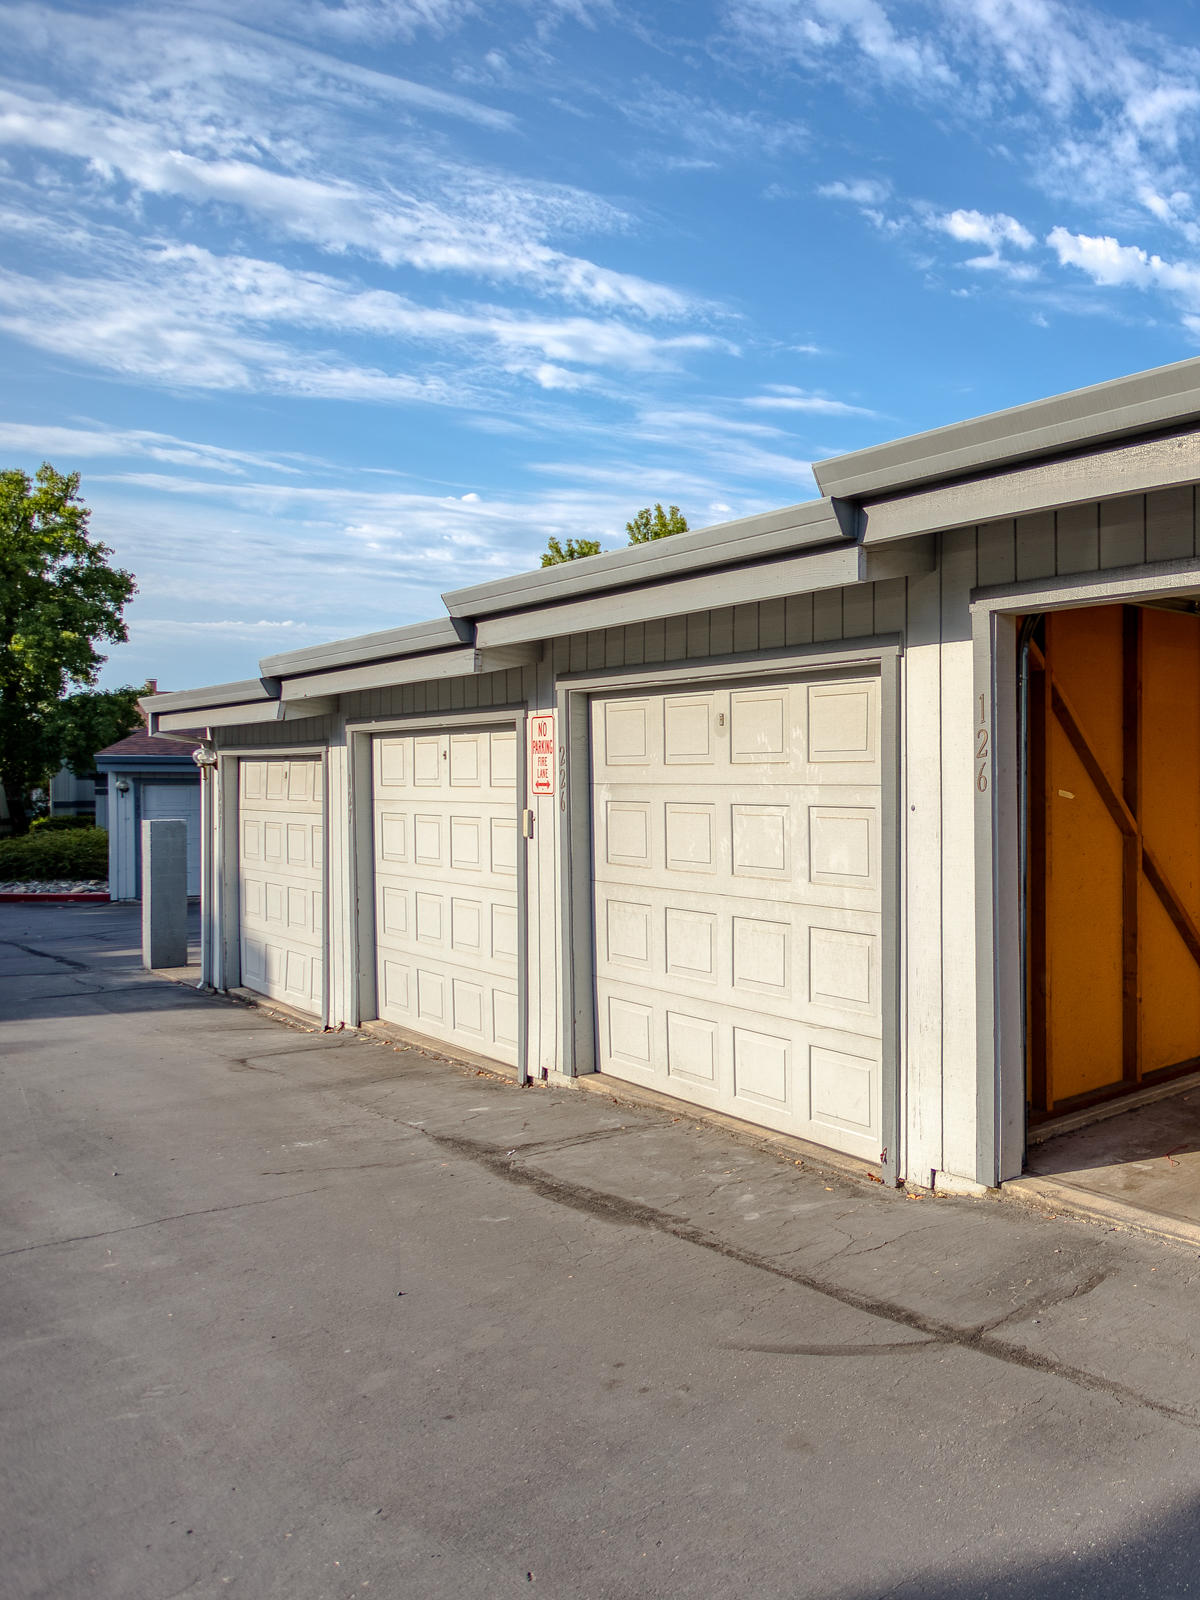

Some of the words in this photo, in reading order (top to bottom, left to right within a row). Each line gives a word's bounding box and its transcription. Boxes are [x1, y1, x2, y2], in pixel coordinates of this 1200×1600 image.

[538, 722, 547, 737] NO
[532, 740, 553, 754] PARKING
[976, 693, 989, 792] 126
[537, 756, 548, 767] FIRE
[537, 768, 549, 779] LANE
